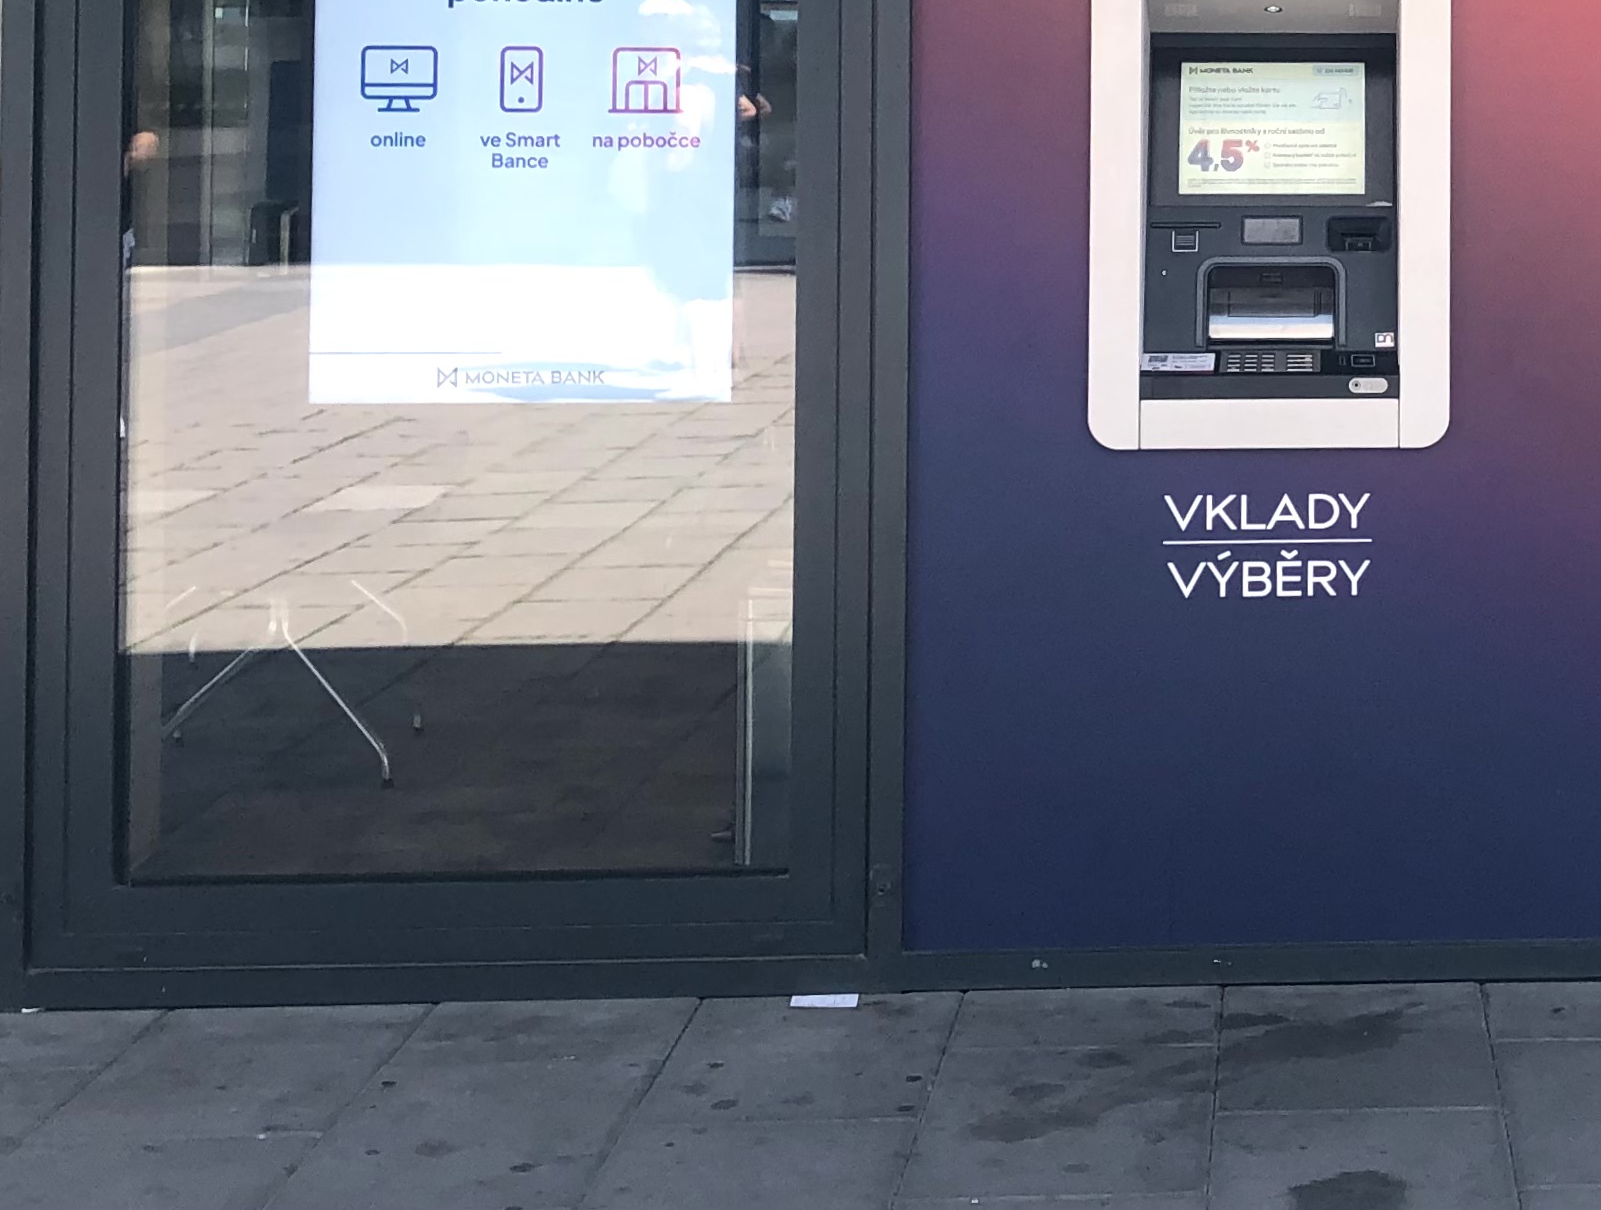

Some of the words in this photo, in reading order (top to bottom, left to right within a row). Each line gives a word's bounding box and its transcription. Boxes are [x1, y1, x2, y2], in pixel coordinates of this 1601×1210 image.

[370, 132, 427, 148] online
[480, 136, 501, 148] ve
[505, 132, 561, 148] Smart
[592, 136, 614, 148] na
[617, 131, 701, 151] pobočce
[491, 153, 549, 169] Bance
[465, 370, 545, 385] MONETA
[551, 370, 605, 385] BANK
[1164, 493, 1371, 531] VKLADY
[1167, 550, 1371, 599] VÝBĚRY
